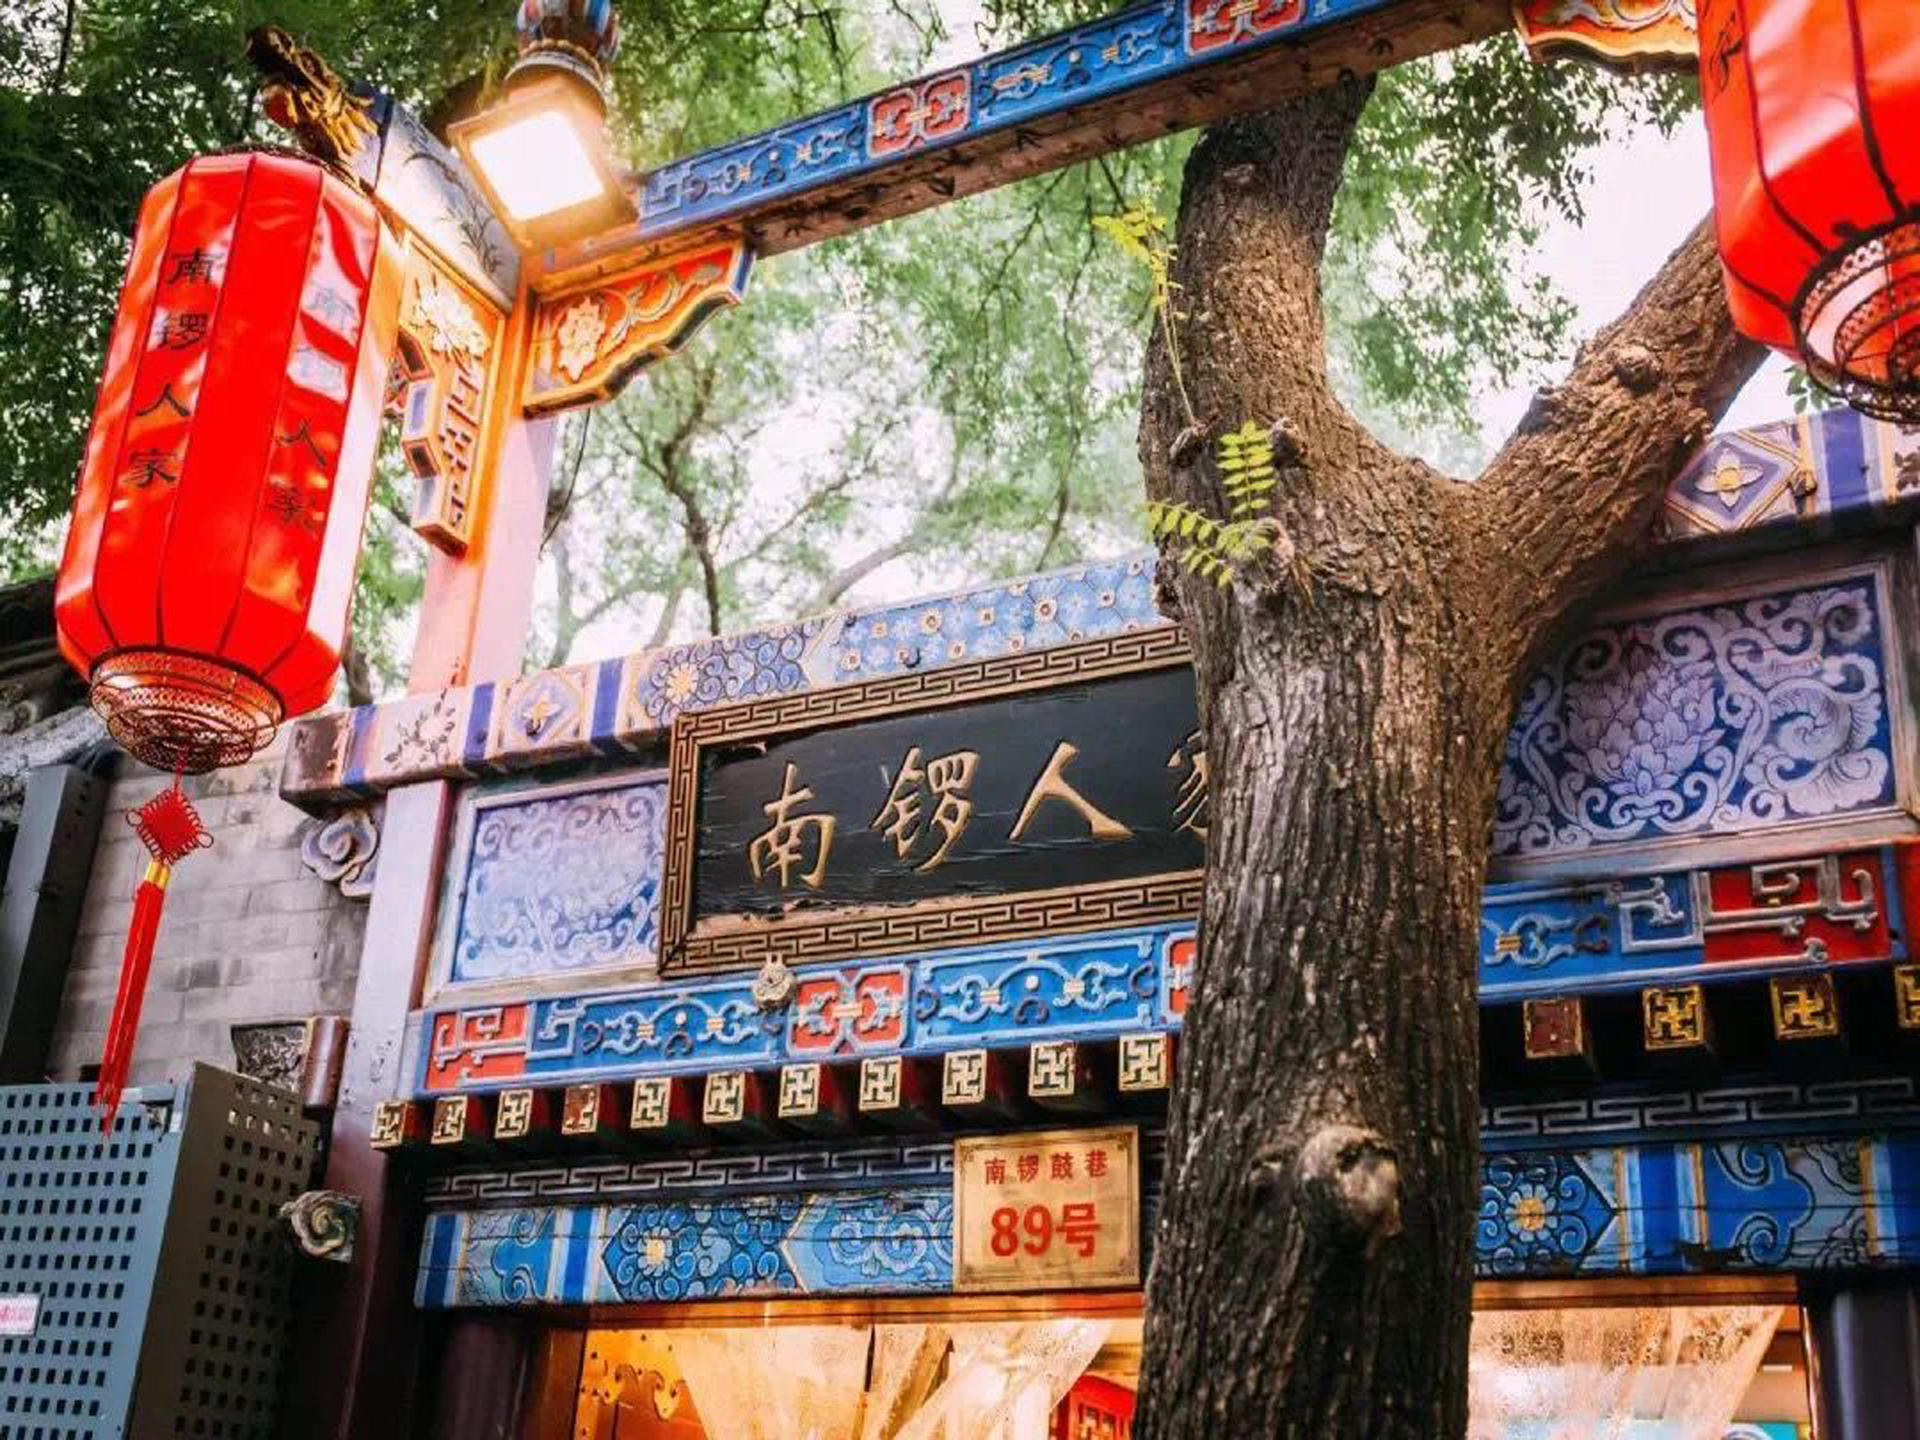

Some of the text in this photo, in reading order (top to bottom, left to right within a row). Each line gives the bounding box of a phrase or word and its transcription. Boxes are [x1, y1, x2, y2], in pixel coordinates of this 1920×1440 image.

[121, 247, 224, 488] 南锣人家
[270, 286, 356, 531] 南人家
[984, 1149, 1109, 1185] 南锣鼓巷
[990, 1202, 1101, 1258] 89号
